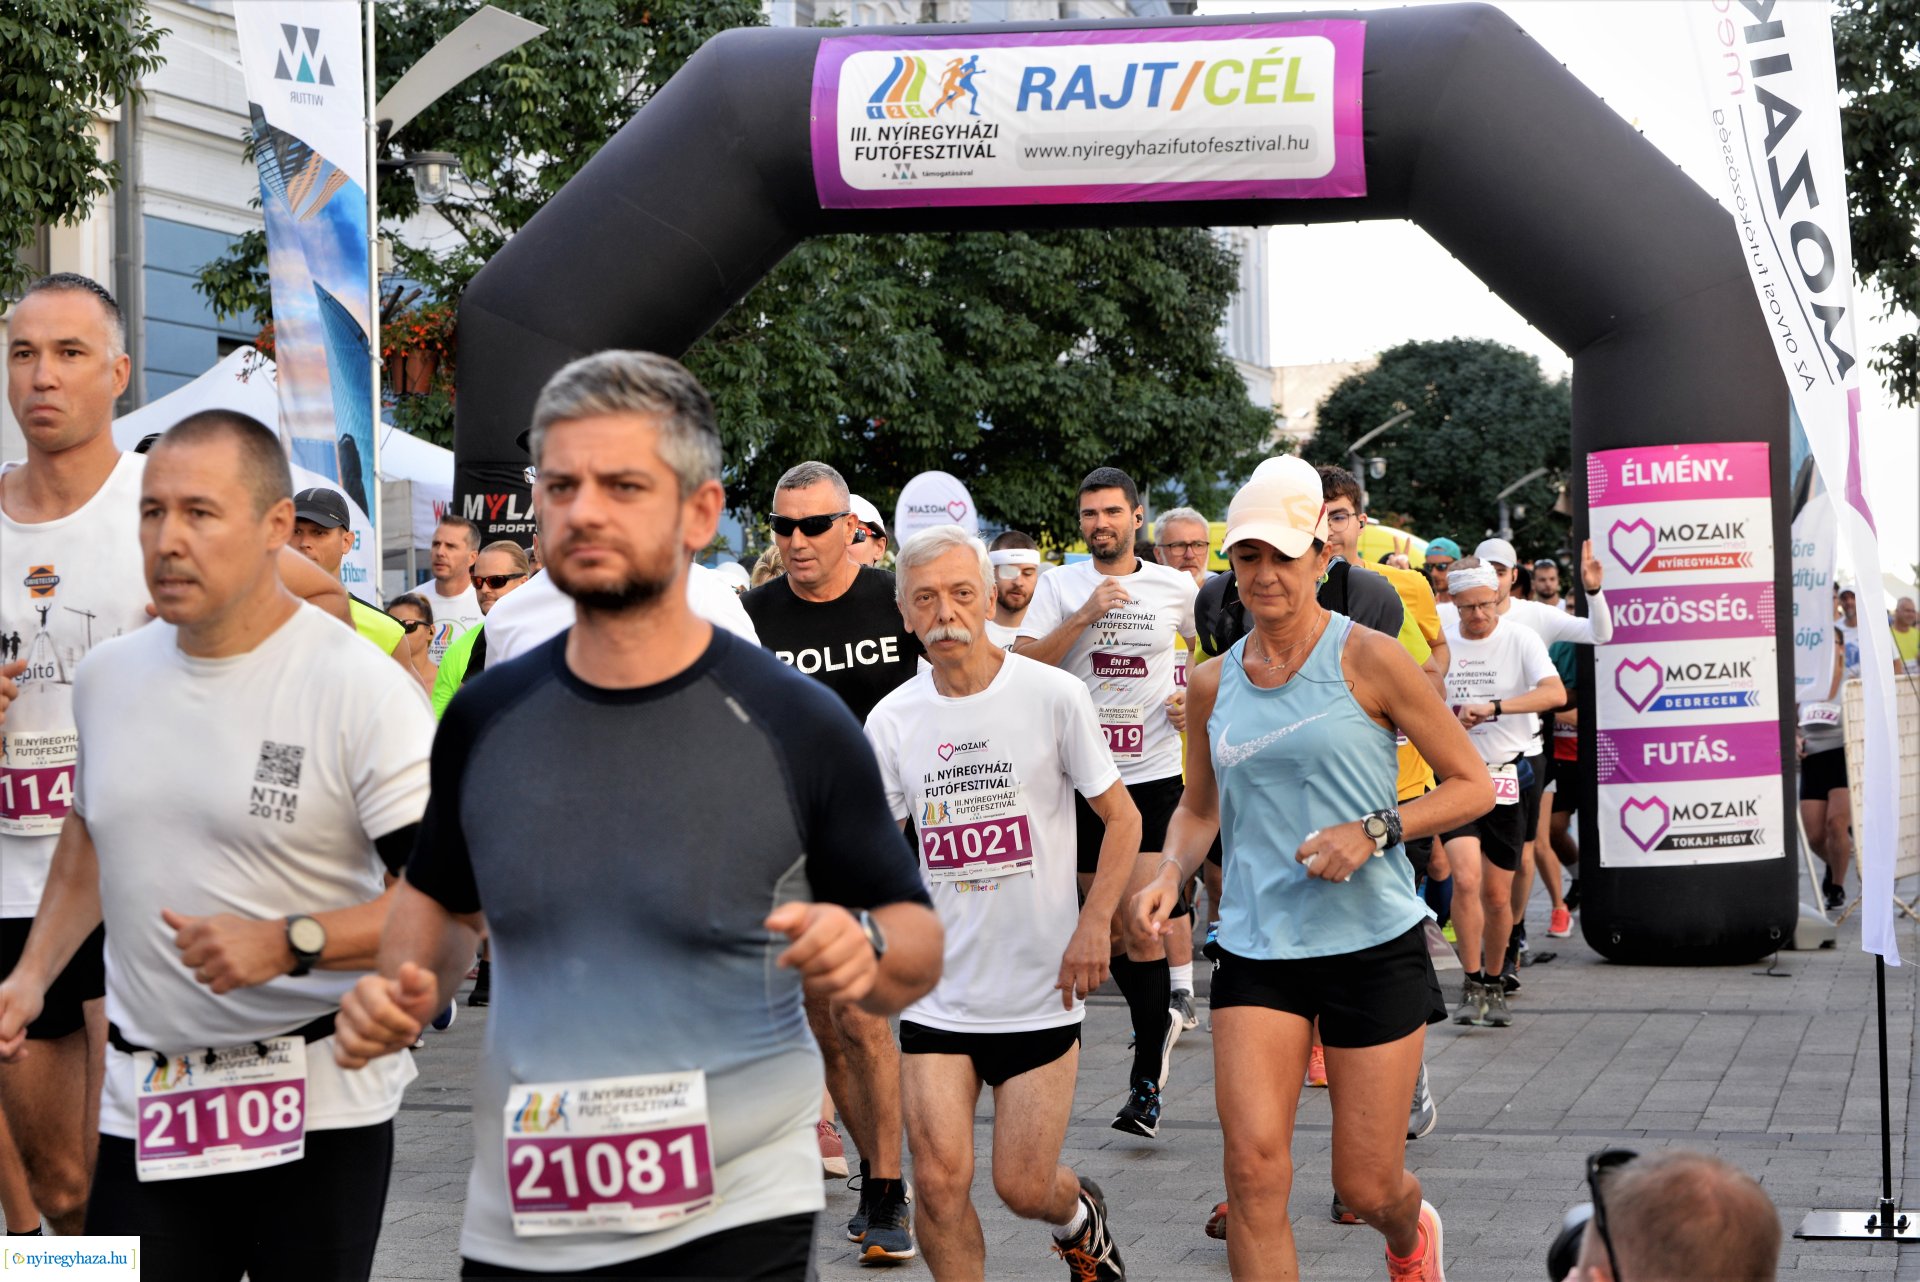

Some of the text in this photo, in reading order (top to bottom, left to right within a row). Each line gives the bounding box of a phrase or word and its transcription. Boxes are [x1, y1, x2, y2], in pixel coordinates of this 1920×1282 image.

[1015, 46, 1316, 113] RAJT/CÉL
[850, 121, 999, 142] III. NYÍREGYHÁZI
[855, 141, 996, 161] FUTÓFESZTIVÁL
[1023, 136, 1309, 161] www.nyiregyhazifutofesztival.hu
[1621, 454, 1733, 487] ÉLMÉNY.
[488, 523, 538, 533] SPORT
[1658, 522, 1745, 542] MOZAIK
[1657, 556, 1735, 568] NYÍREGYHÁZA
[1103, 612, 1156, 621] NYÍREGYHÁZI
[1613, 593, 1754, 627] KÖZÖSSÉG.
[1091, 621, 1155, 631] FUTÓFESZTIVÁL
[775, 636, 900, 674] POLICE
[1110, 657, 1121, 666] ÉN
[1096, 667, 1145, 676] LEFUTOTTAM
[1666, 661, 1752, 681] MOZAIK
[1665, 695, 1737, 708] DEBRECEN
[954, 741, 988, 753] MOZAIK
[1643, 735, 1736, 766] FUTÁS.
[937, 760, 1013, 781] NYÍREGYHÁZI
[925, 776, 1011, 798] FUTÓFESZTIVÁL
[250, 786, 298, 809] NTM
[956, 799, 1017, 815] FUTÓFESZTIVÁL
[249, 803, 296, 823] 2015
[1672, 799, 1757, 821] MOZAIK
[925, 821, 1023, 862] 21021
[1672, 834, 1747, 847] TOKAJI-HEGY
[142, 1086, 302, 1148] 21108
[511, 1134, 699, 1199] 21081
